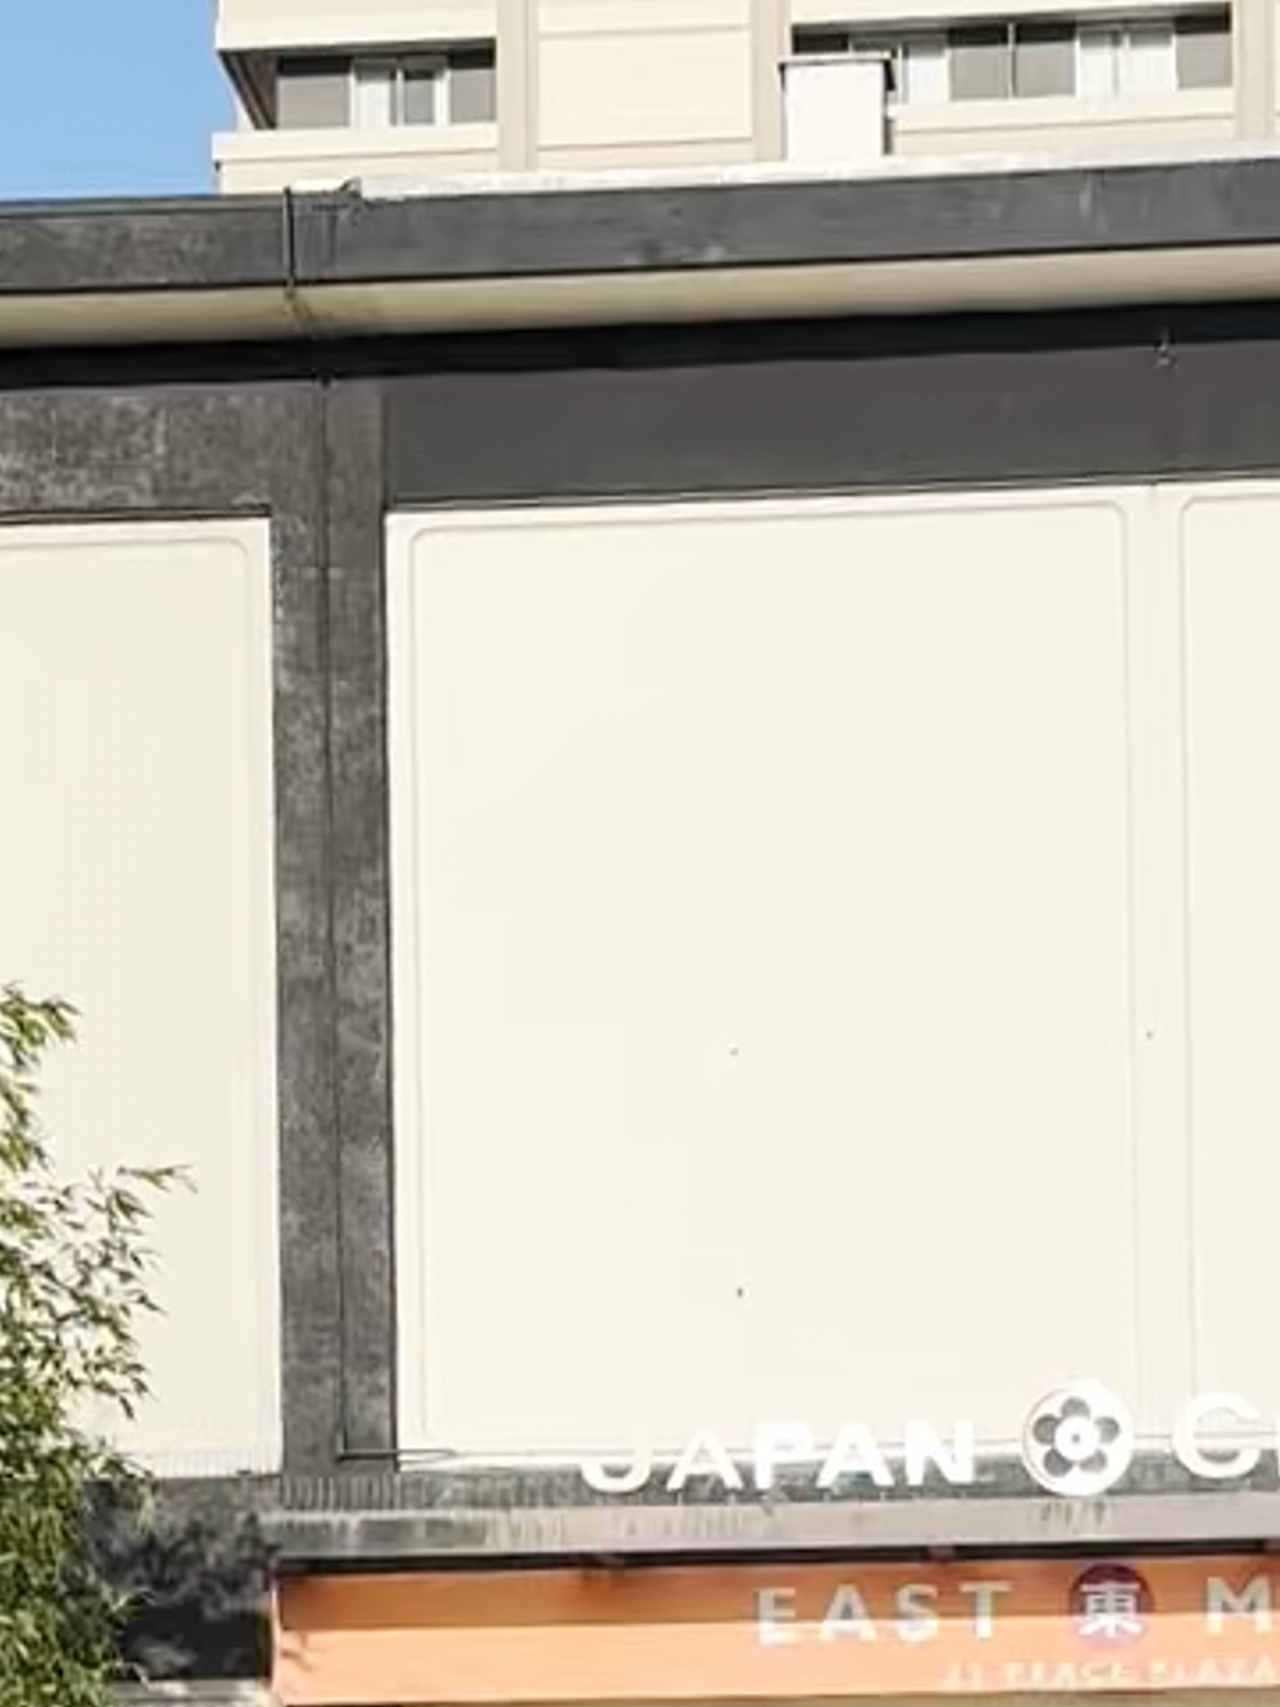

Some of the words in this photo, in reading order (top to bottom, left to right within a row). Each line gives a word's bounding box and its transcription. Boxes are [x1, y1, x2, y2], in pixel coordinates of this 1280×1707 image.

[579, 1415, 976, 1493] JAPAN
[756, 1580, 1012, 1645] EAST
[1078, 1581, 1142, 1637] 東
